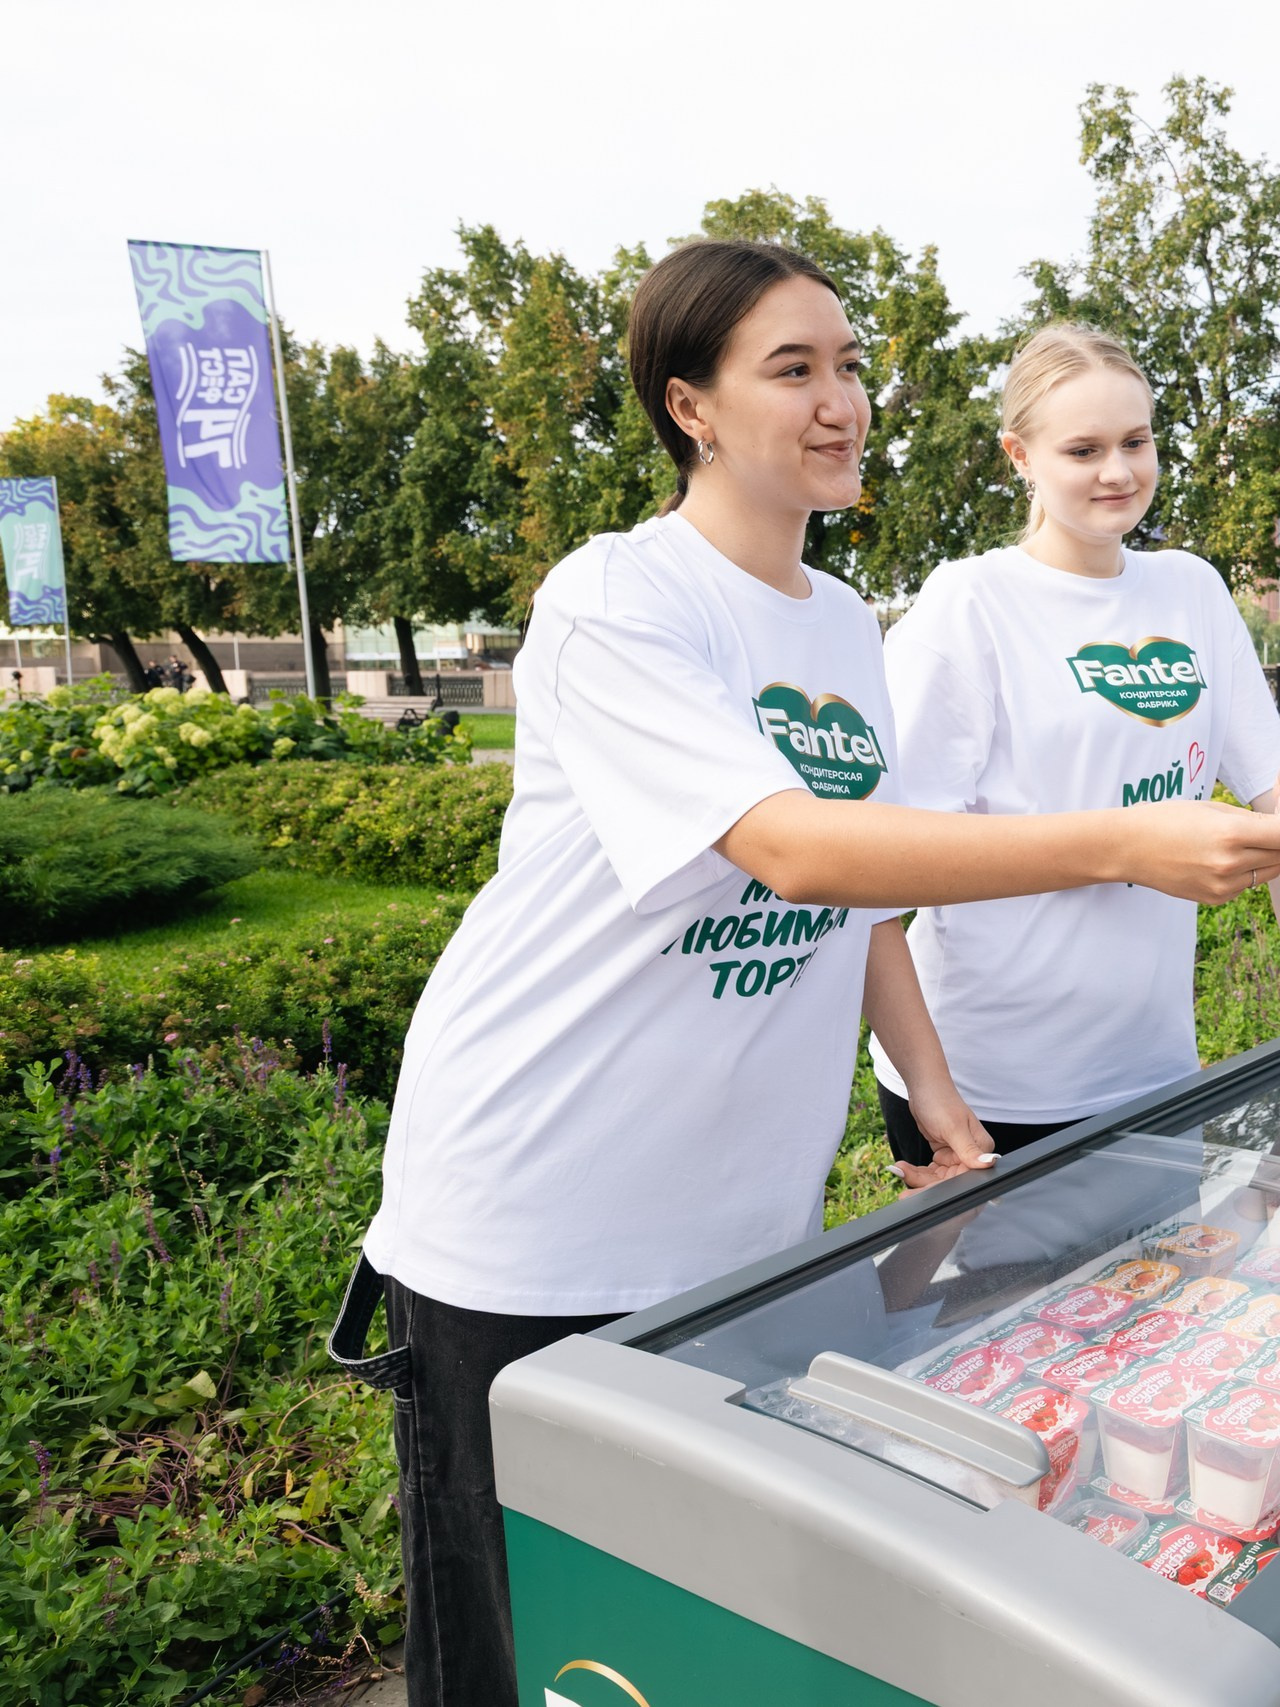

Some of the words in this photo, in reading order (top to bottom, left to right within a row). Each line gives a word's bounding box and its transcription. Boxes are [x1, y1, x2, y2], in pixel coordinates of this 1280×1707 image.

[1072, 653, 1205, 690] Fantel
[1119, 689, 1188, 700] КОНДИТЕРСКАЯ
[1136, 700, 1179, 709] ФАБРИКА
[756, 704, 884, 768] Fantel
[799, 763, 863, 782] КОНДИТЕРСКАЯ
[1123, 760, 1184, 808] МОЙ
[811, 780, 850, 795] ФАБРИКА
[916, 1355, 955, 1384] Fantel
[929, 1353, 984, 1389] ливочное
[941, 1359, 986, 1391] суфле
[1105, 1367, 1140, 1389] Fantel
[1117, 1370, 1172, 1405] Сливочное
[1132, 1375, 1175, 1404] суфле
[1198, 1390, 1229, 1410] Fantel
[1212, 1392, 1262, 1425] Сливочное
[1227, 1398, 1266, 1425] суфле
[1130, 1535, 1160, 1560] antel
[1223, 1555, 1256, 1585] Fantel
